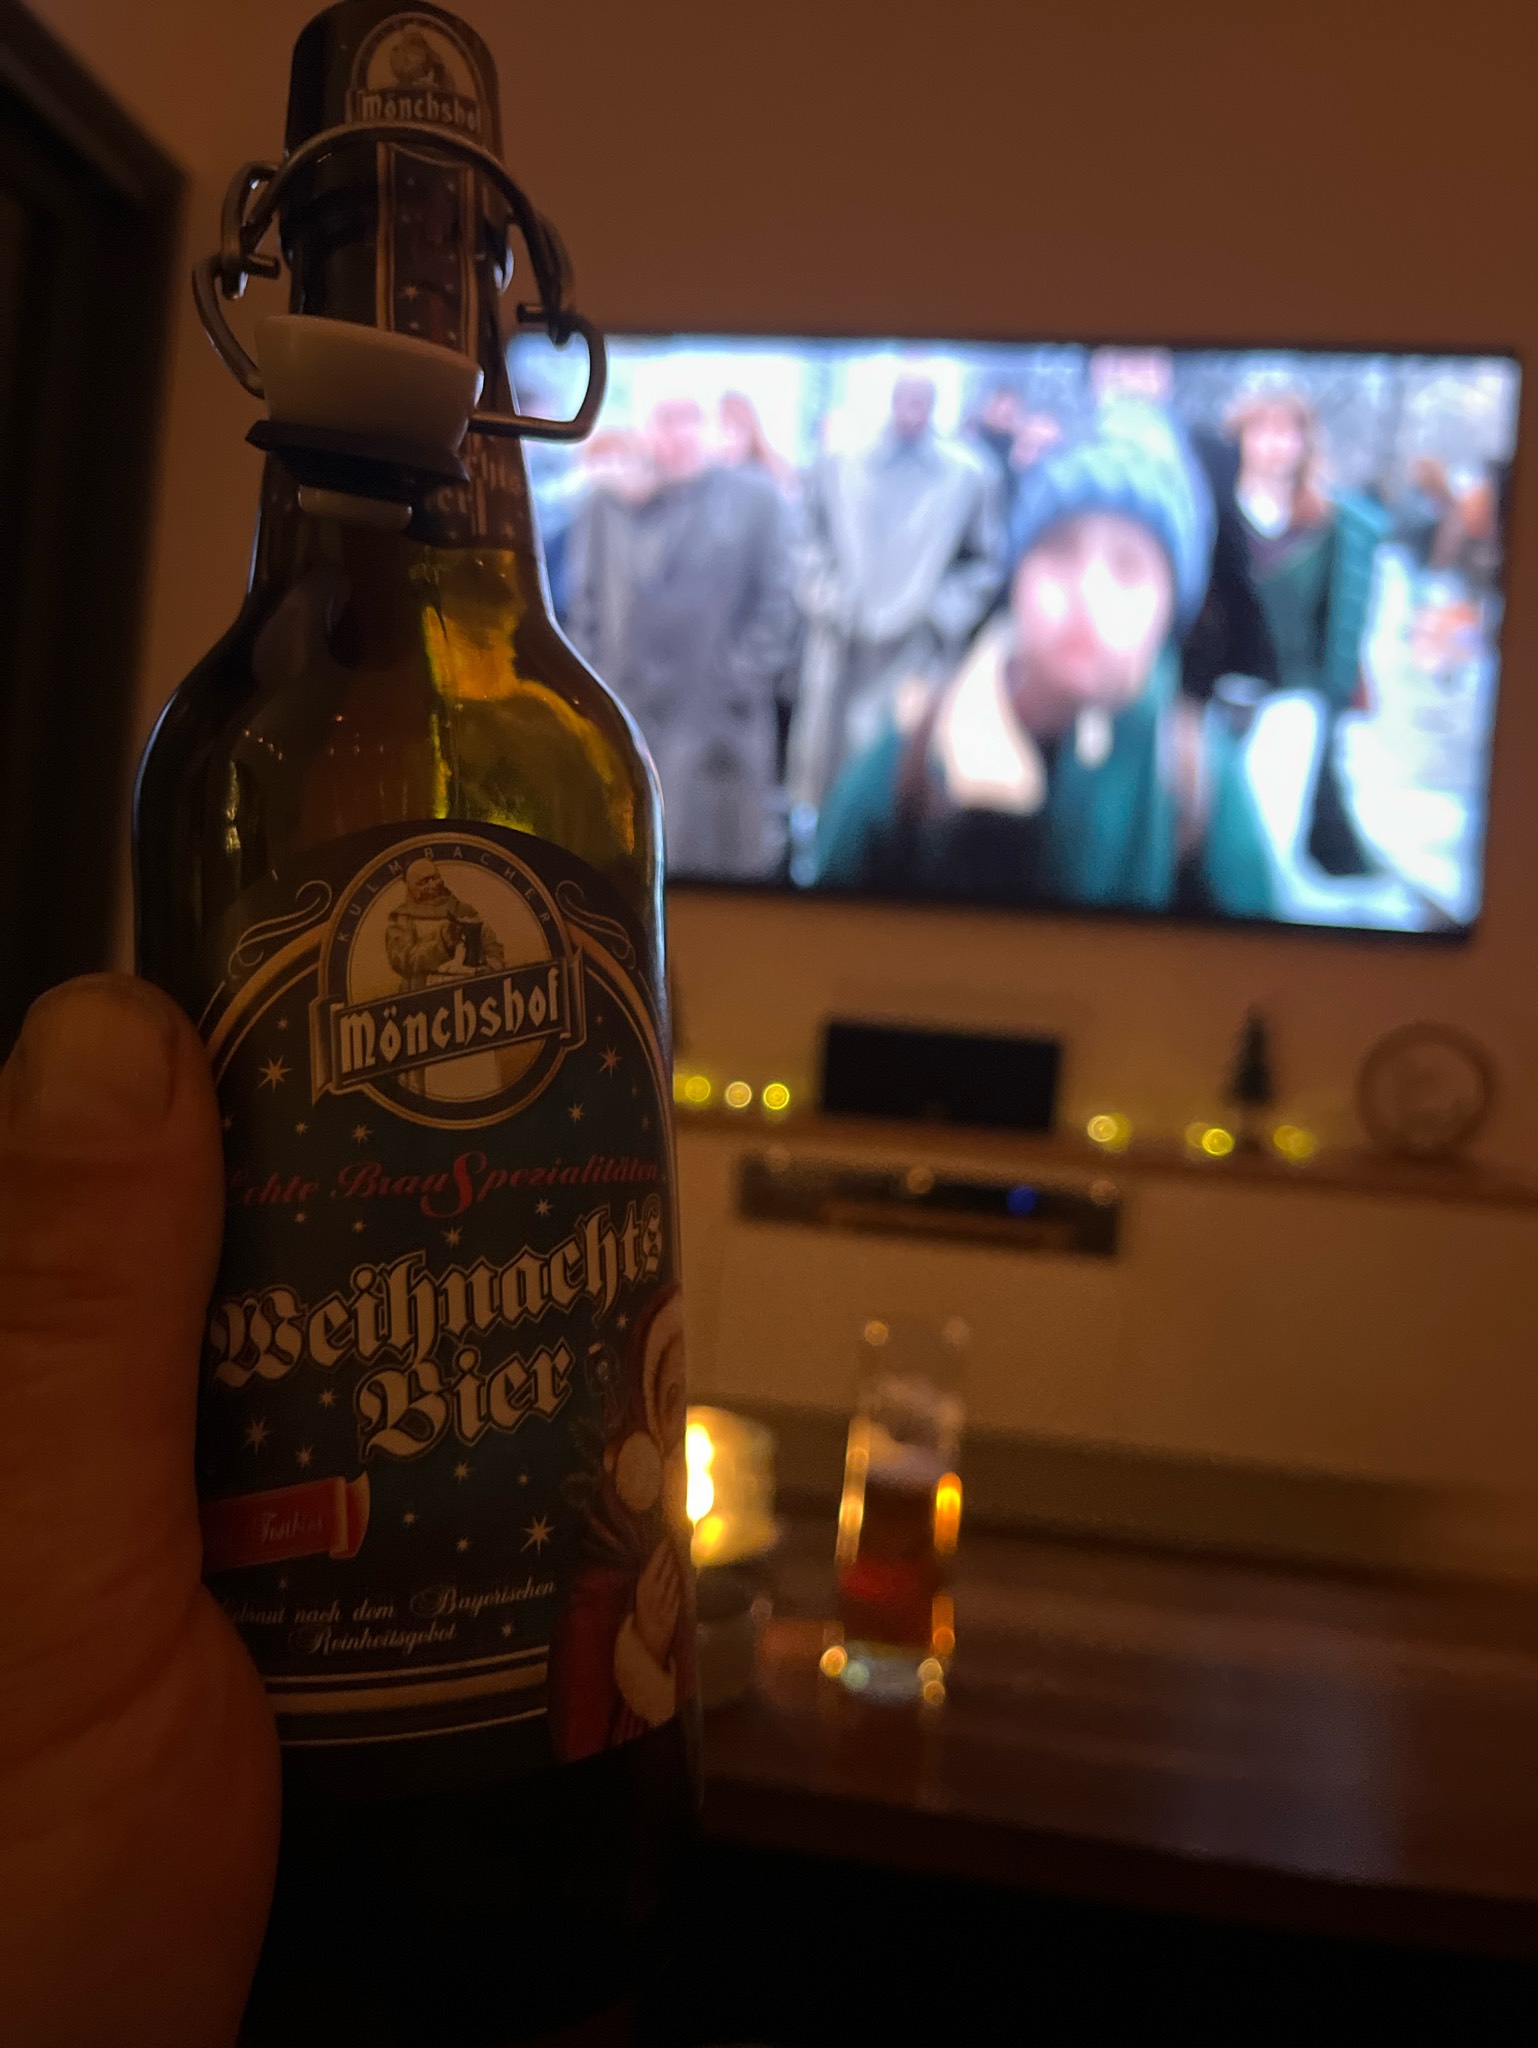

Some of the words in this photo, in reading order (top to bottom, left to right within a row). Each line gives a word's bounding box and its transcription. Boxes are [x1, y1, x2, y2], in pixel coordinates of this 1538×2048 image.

[337, 845, 552, 942] KULMBACHER
[339, 966, 560, 1074] Mönchshof
[208, 1193, 665, 1390] Weihnachts
[354, 1336, 576, 1463] Bier
[294, 1599, 341, 1624] nach
[353, 1595, 394, 1622] dem
